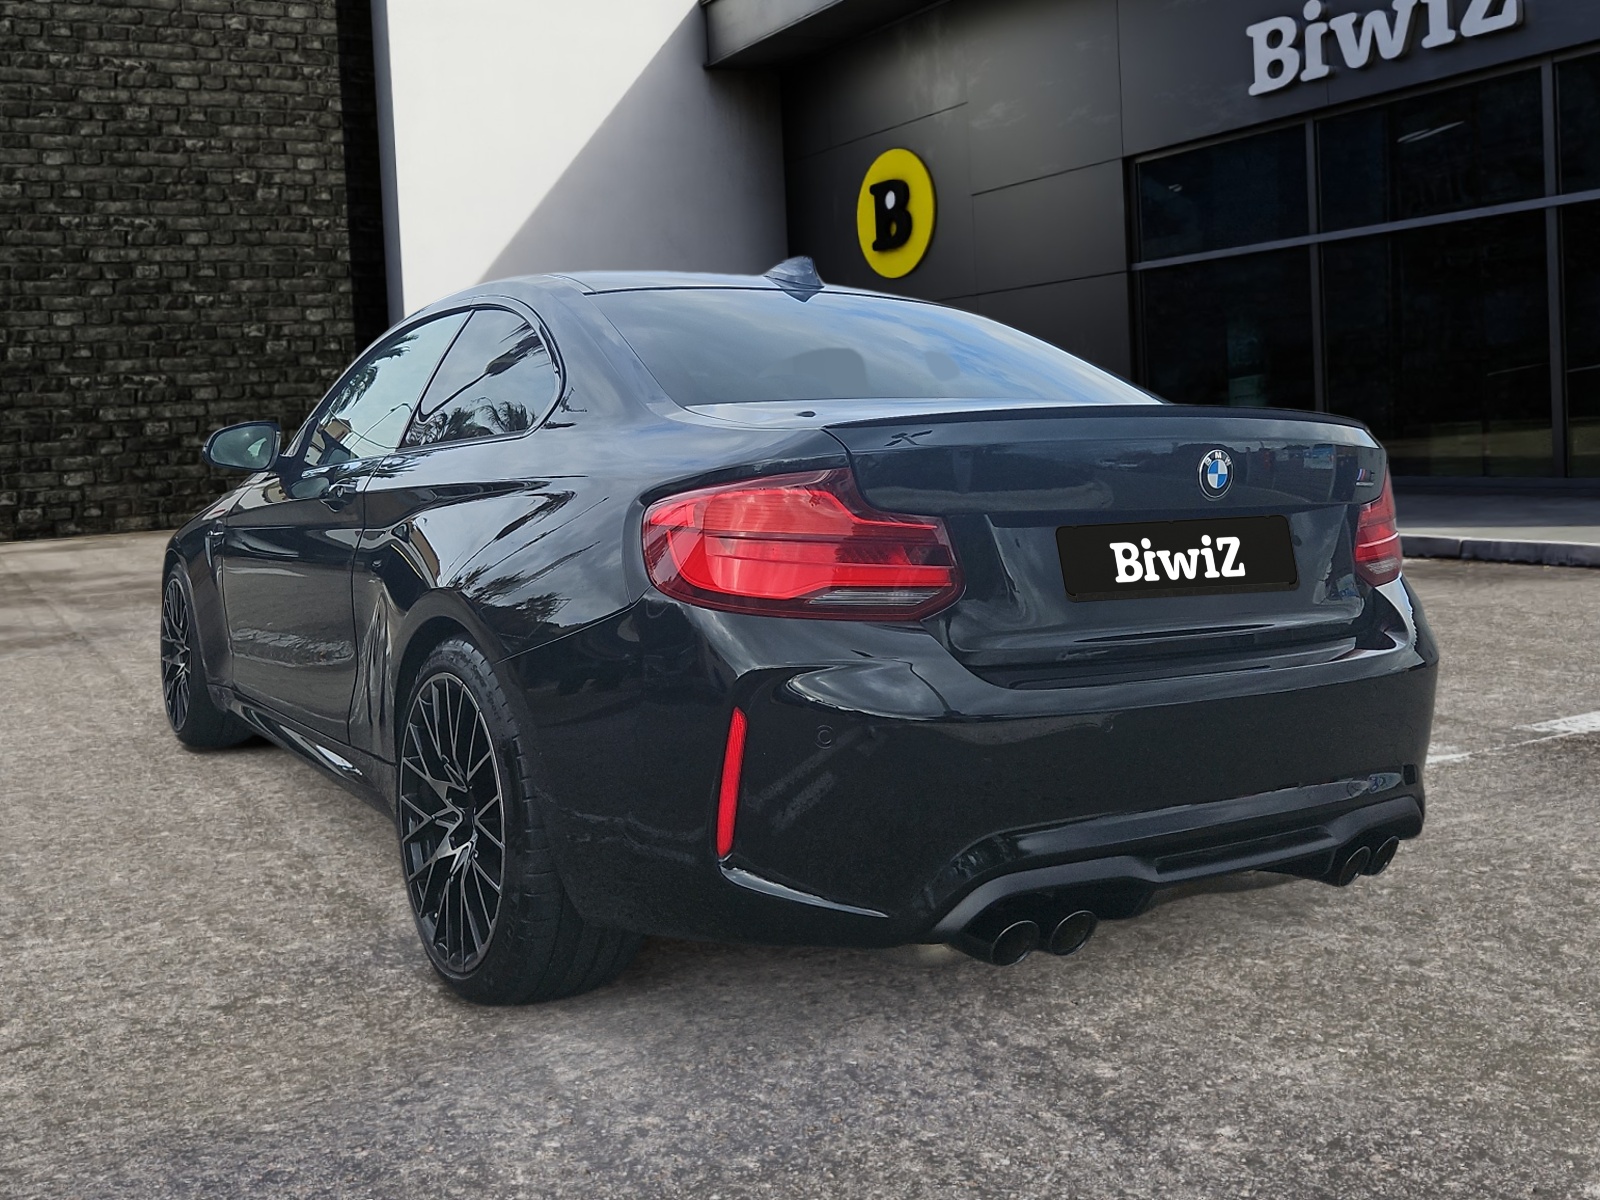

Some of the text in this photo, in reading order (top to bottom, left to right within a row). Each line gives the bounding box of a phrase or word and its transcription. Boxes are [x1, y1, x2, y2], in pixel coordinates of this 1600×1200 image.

[869, 179, 913, 252] B
[1204, 451, 1232, 467] BMW
[1109, 534, 1246, 583] BiwiZ
